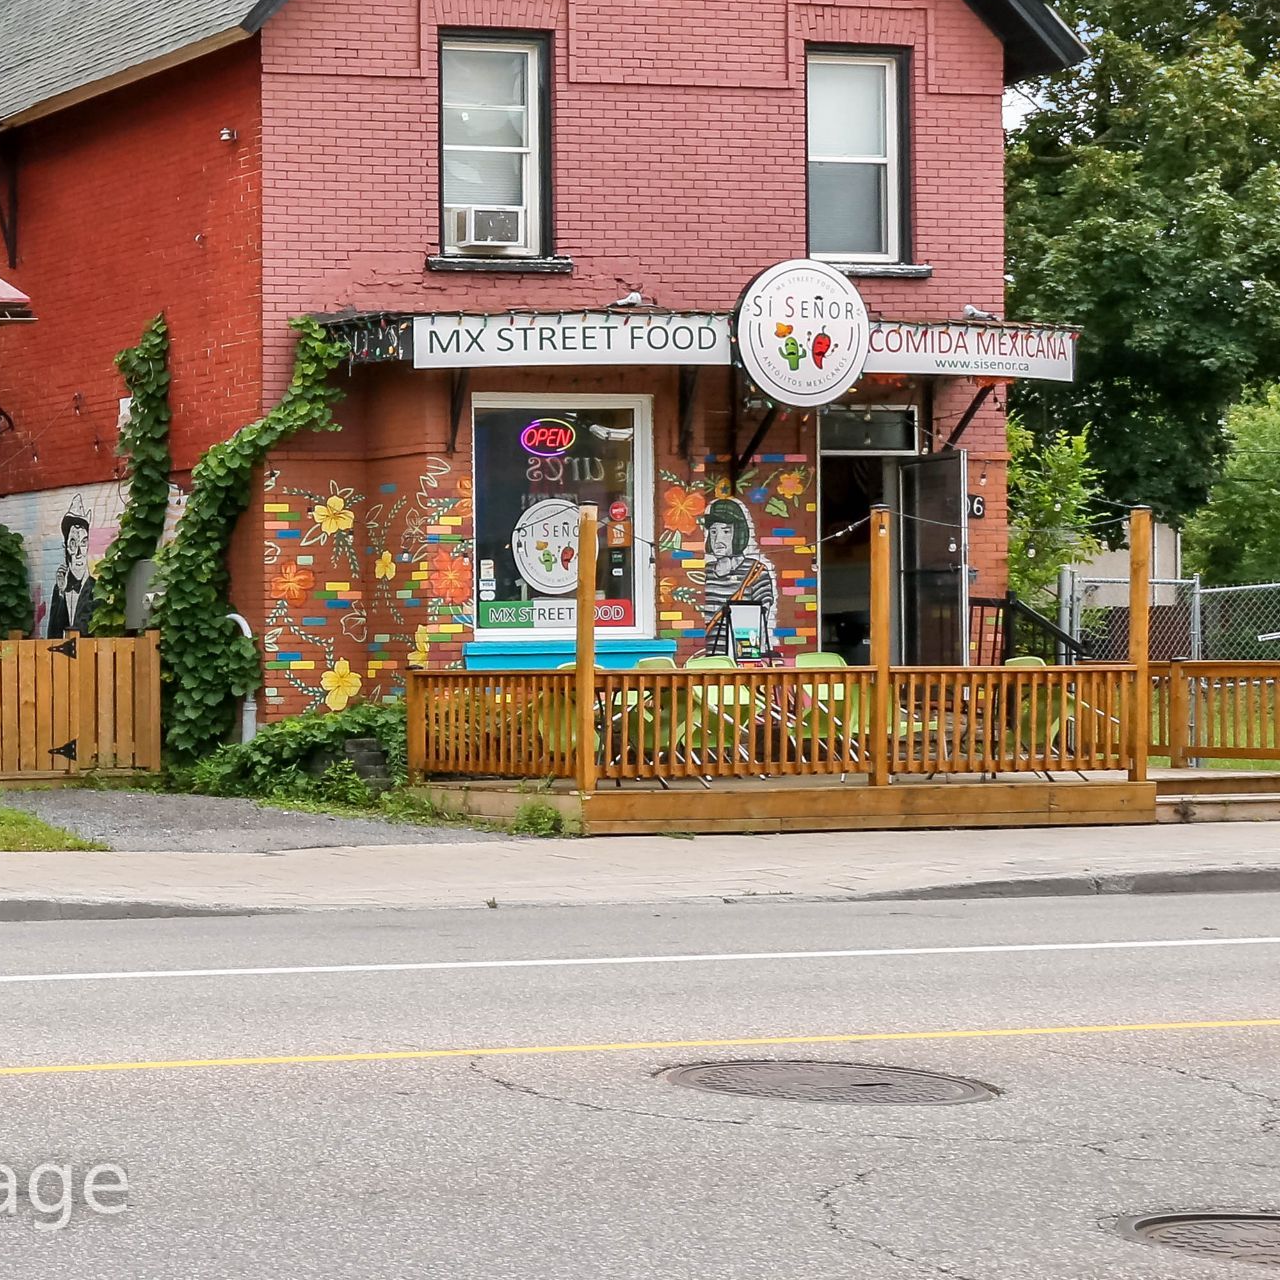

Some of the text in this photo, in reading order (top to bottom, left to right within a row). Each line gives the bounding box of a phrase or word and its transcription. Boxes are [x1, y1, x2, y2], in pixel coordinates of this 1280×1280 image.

[427, 325, 718, 354] MX STREET FOOD
[869, 328, 1069, 361] COMIDA MEXICANA
[806, 357, 847, 387] MEXICANOS
[934, 357, 1030, 372] www.sisenor.ca
[524, 428, 572, 448] OPEN
[542, 521, 580, 538] SEÑO
[489, 607, 516, 623] MX
[518, 606, 575, 622] STREET
